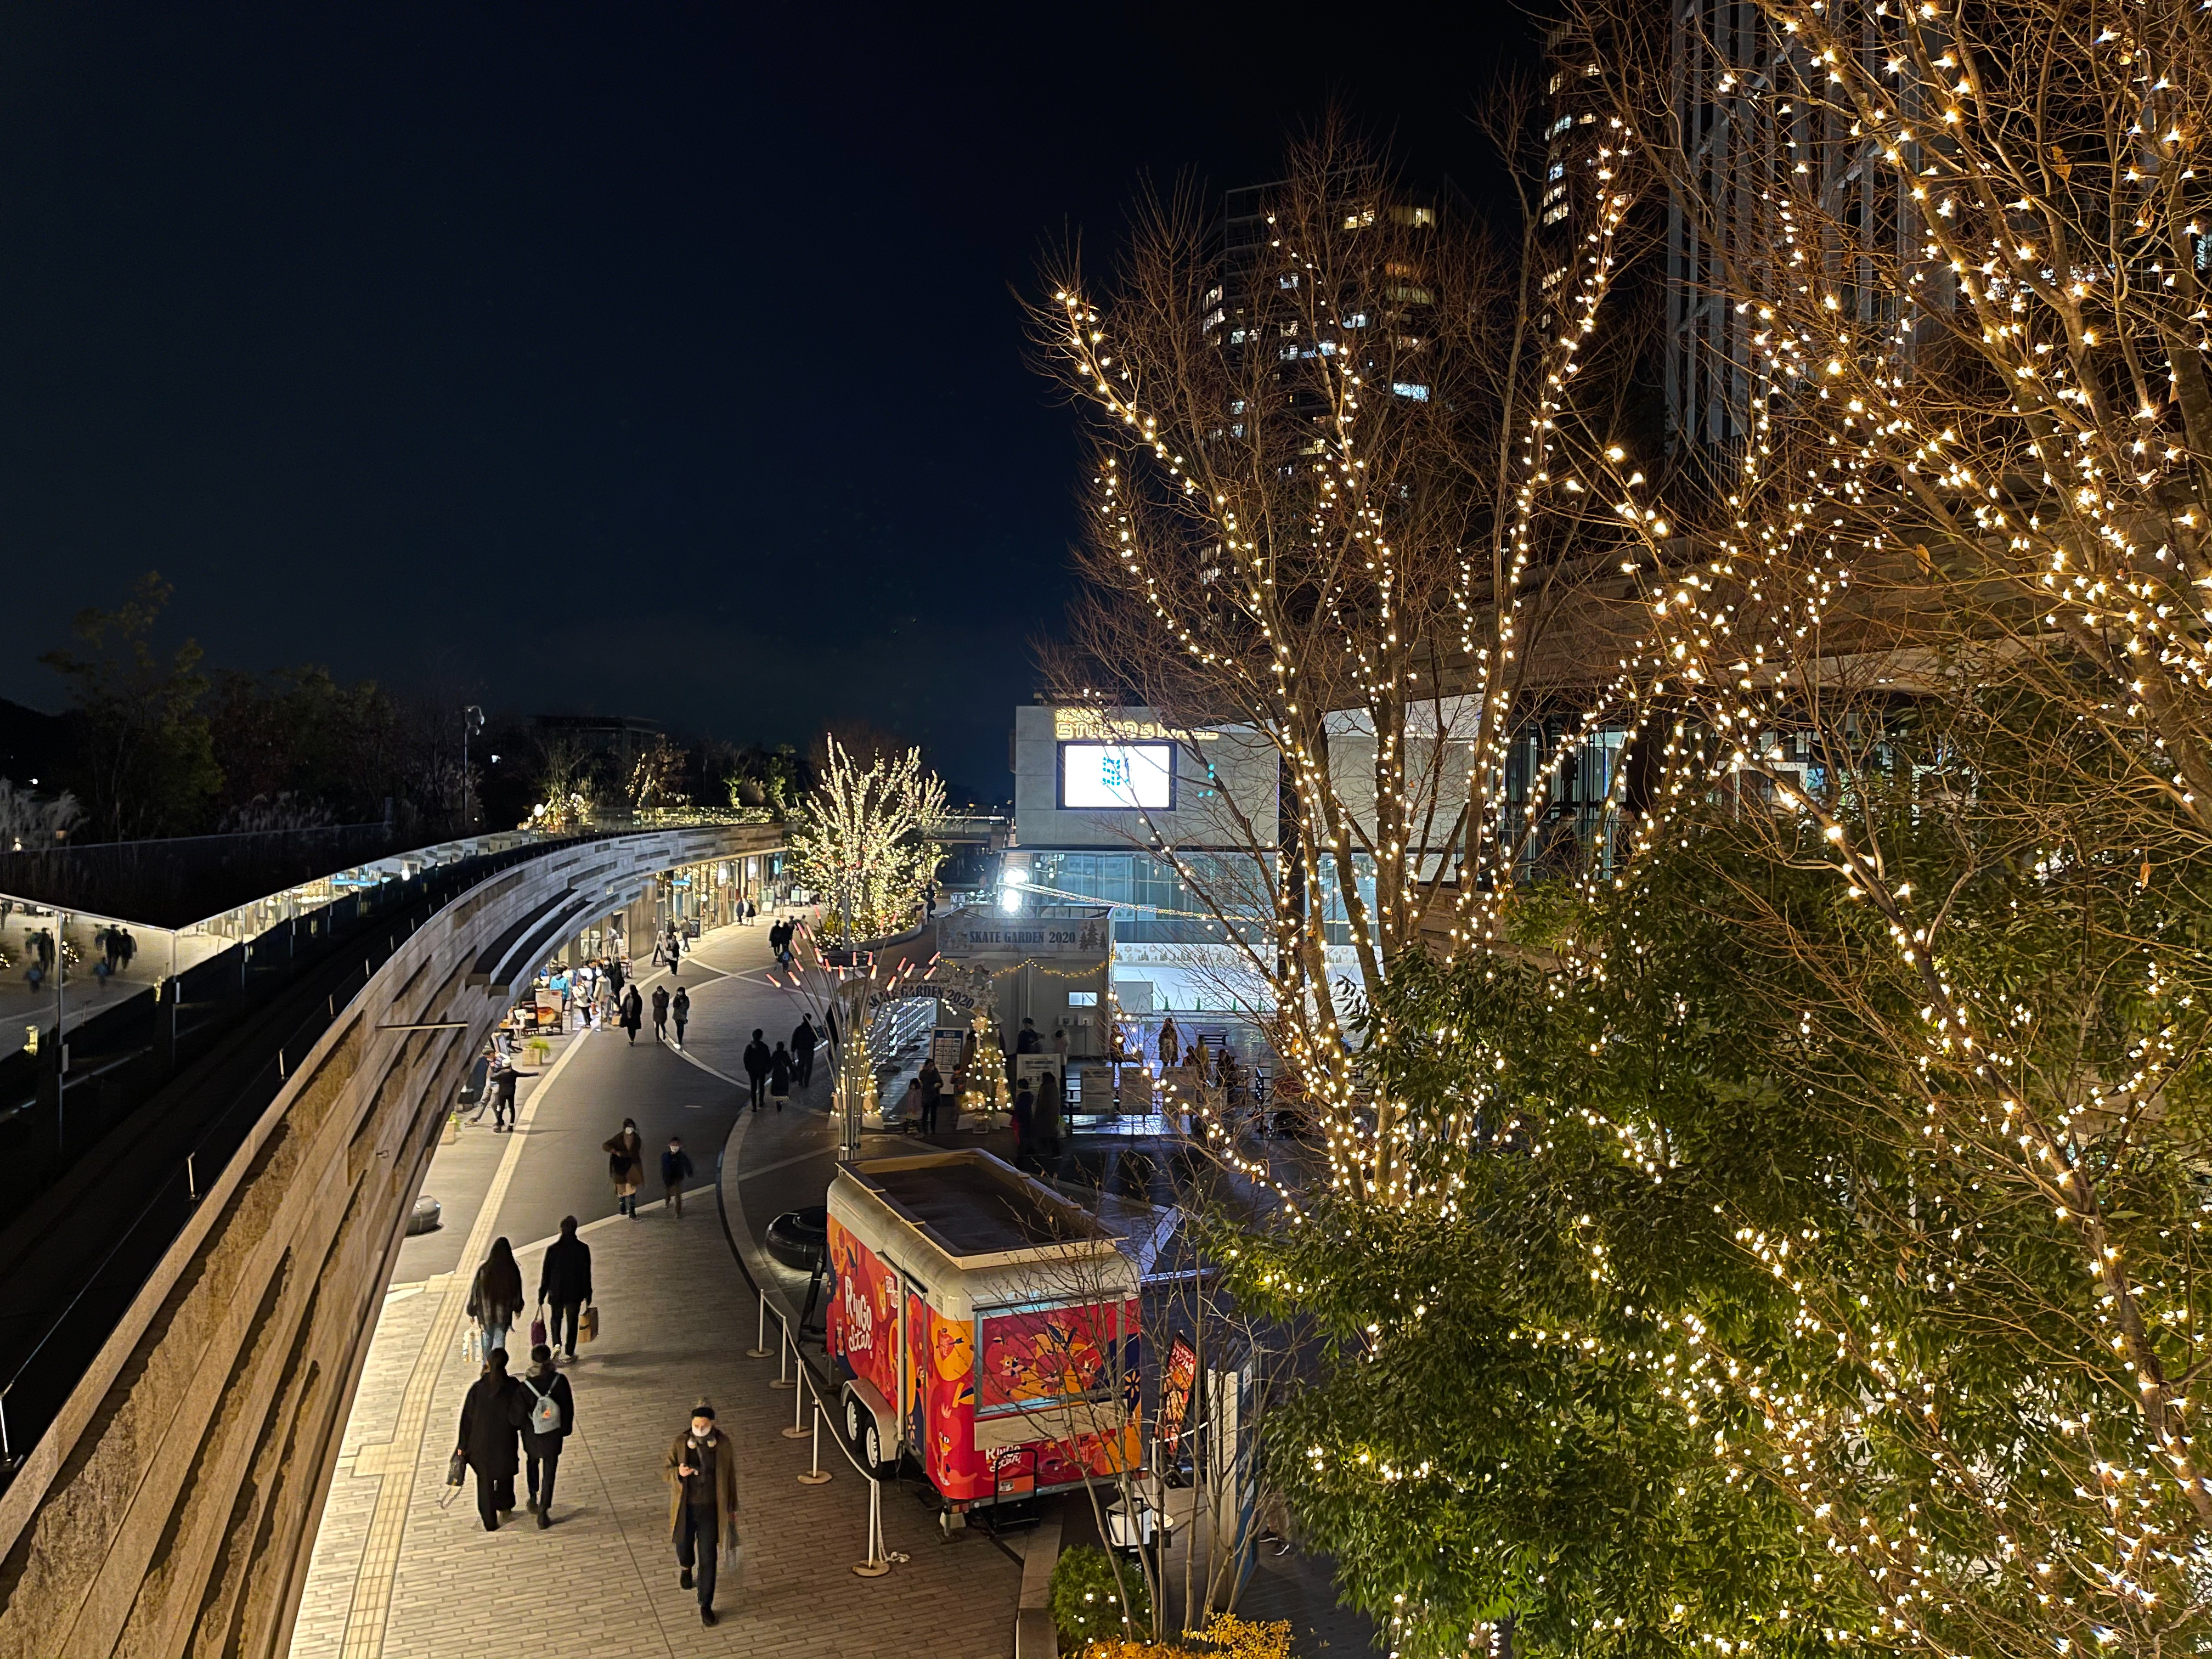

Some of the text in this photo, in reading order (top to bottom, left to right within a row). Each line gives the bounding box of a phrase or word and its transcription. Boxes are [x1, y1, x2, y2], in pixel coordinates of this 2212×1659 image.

[969, 931, 1076, 944] SKATE GARDEN 2020
[900, 985, 944, 999] GARDEN
[947, 989, 975, 1009] 2020
